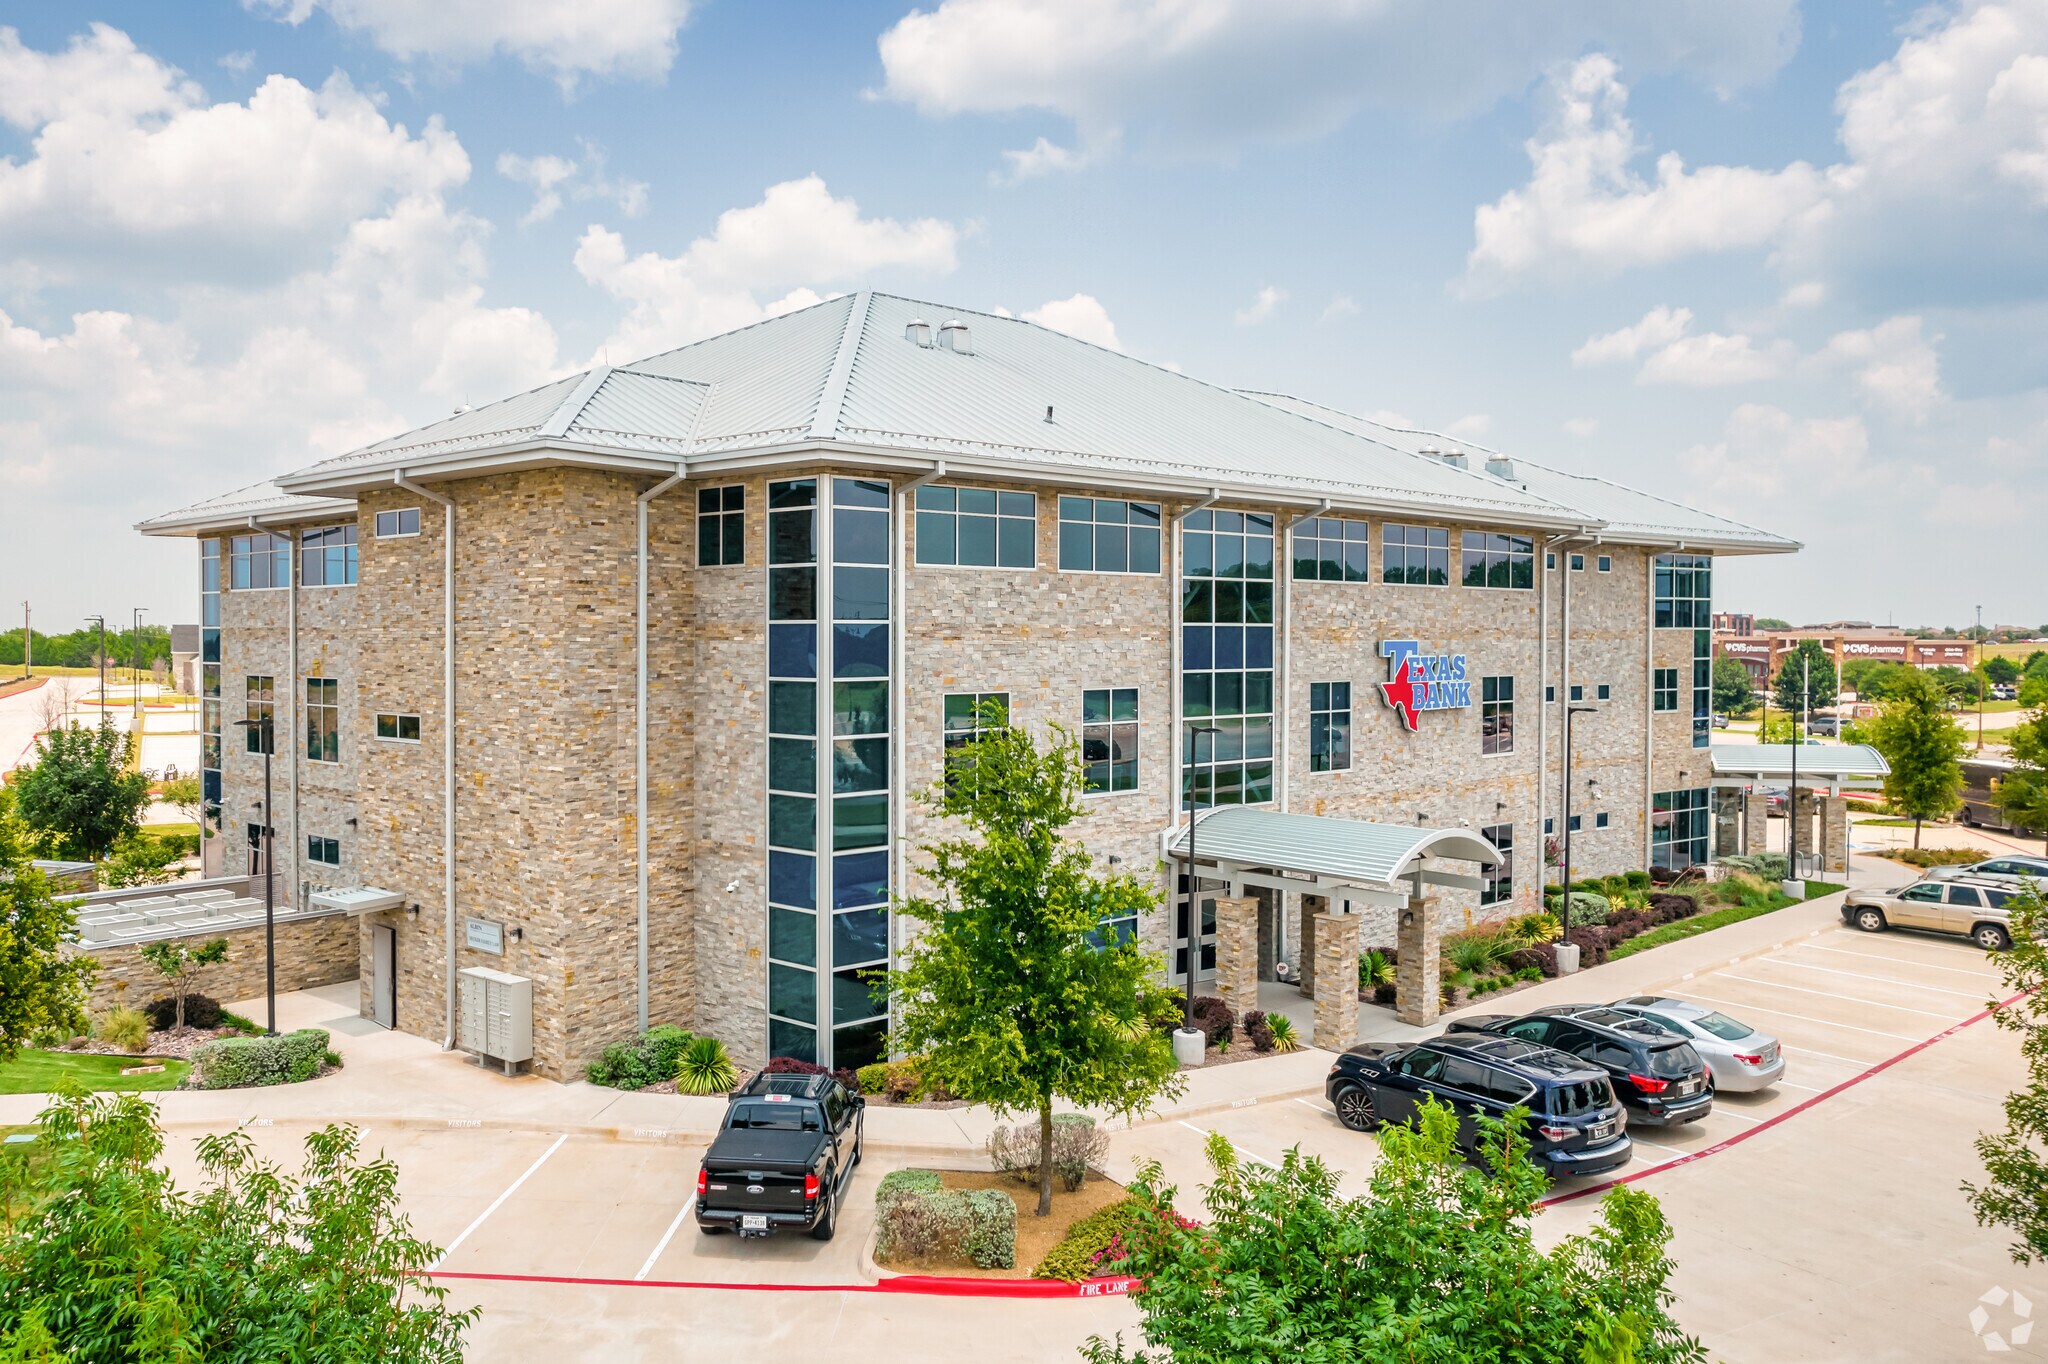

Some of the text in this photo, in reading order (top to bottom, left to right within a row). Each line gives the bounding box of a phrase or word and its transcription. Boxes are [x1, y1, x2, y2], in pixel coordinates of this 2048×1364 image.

[1732, 643, 1747, 652] CVS
[1850, 643, 1905, 654] CVS pharmacy
[1382, 640, 1467, 682] TEXAS
[1411, 681, 1473, 711] BANK
[448, 1119, 482, 1128] VISITORS
[634, 1129, 667, 1138] VISITORS
[1080, 1282, 1129, 1296] FIRE LANE
